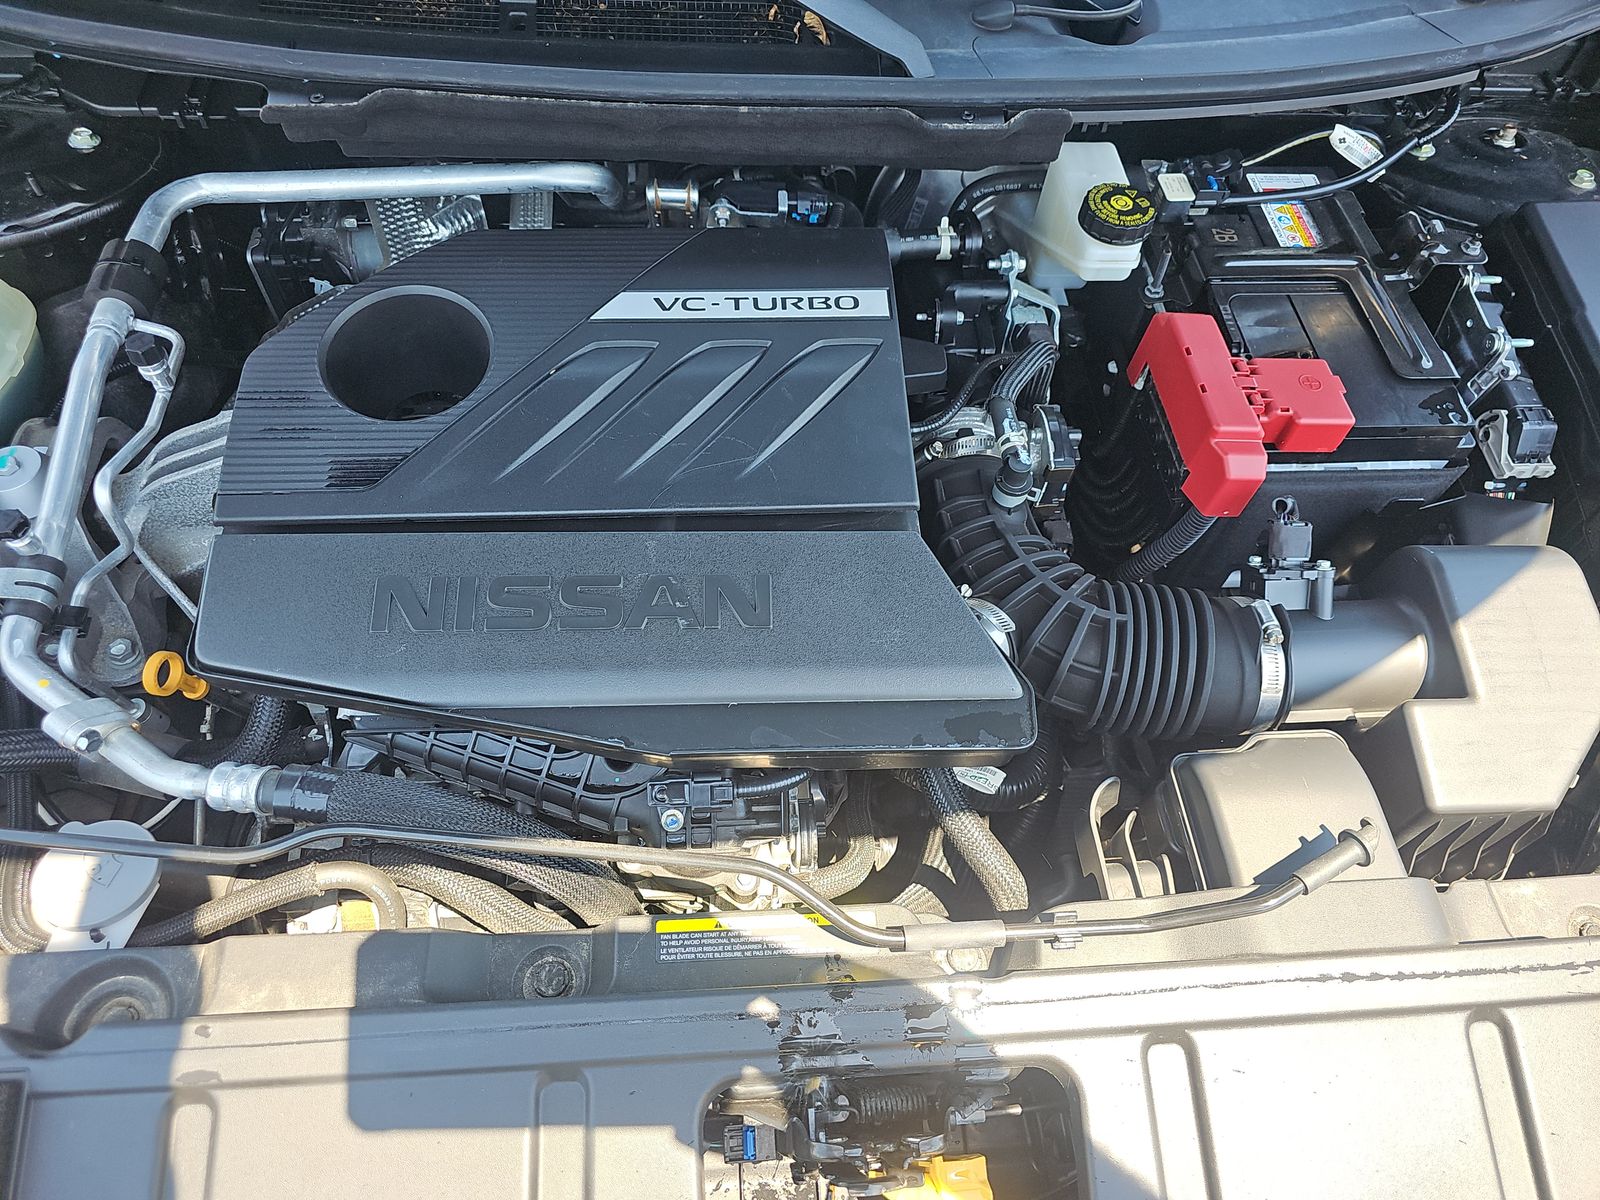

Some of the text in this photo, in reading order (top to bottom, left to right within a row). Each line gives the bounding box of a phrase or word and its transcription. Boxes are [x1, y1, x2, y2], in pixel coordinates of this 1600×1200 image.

[1211, 228, 1239, 242] 2B
[653, 295, 860, 312] VC-TURBO
[368, 574, 773, 633] NISSAN
[732, 943, 762, 951] DÉMARRER
[677, 952, 696, 960] ÉVITER
